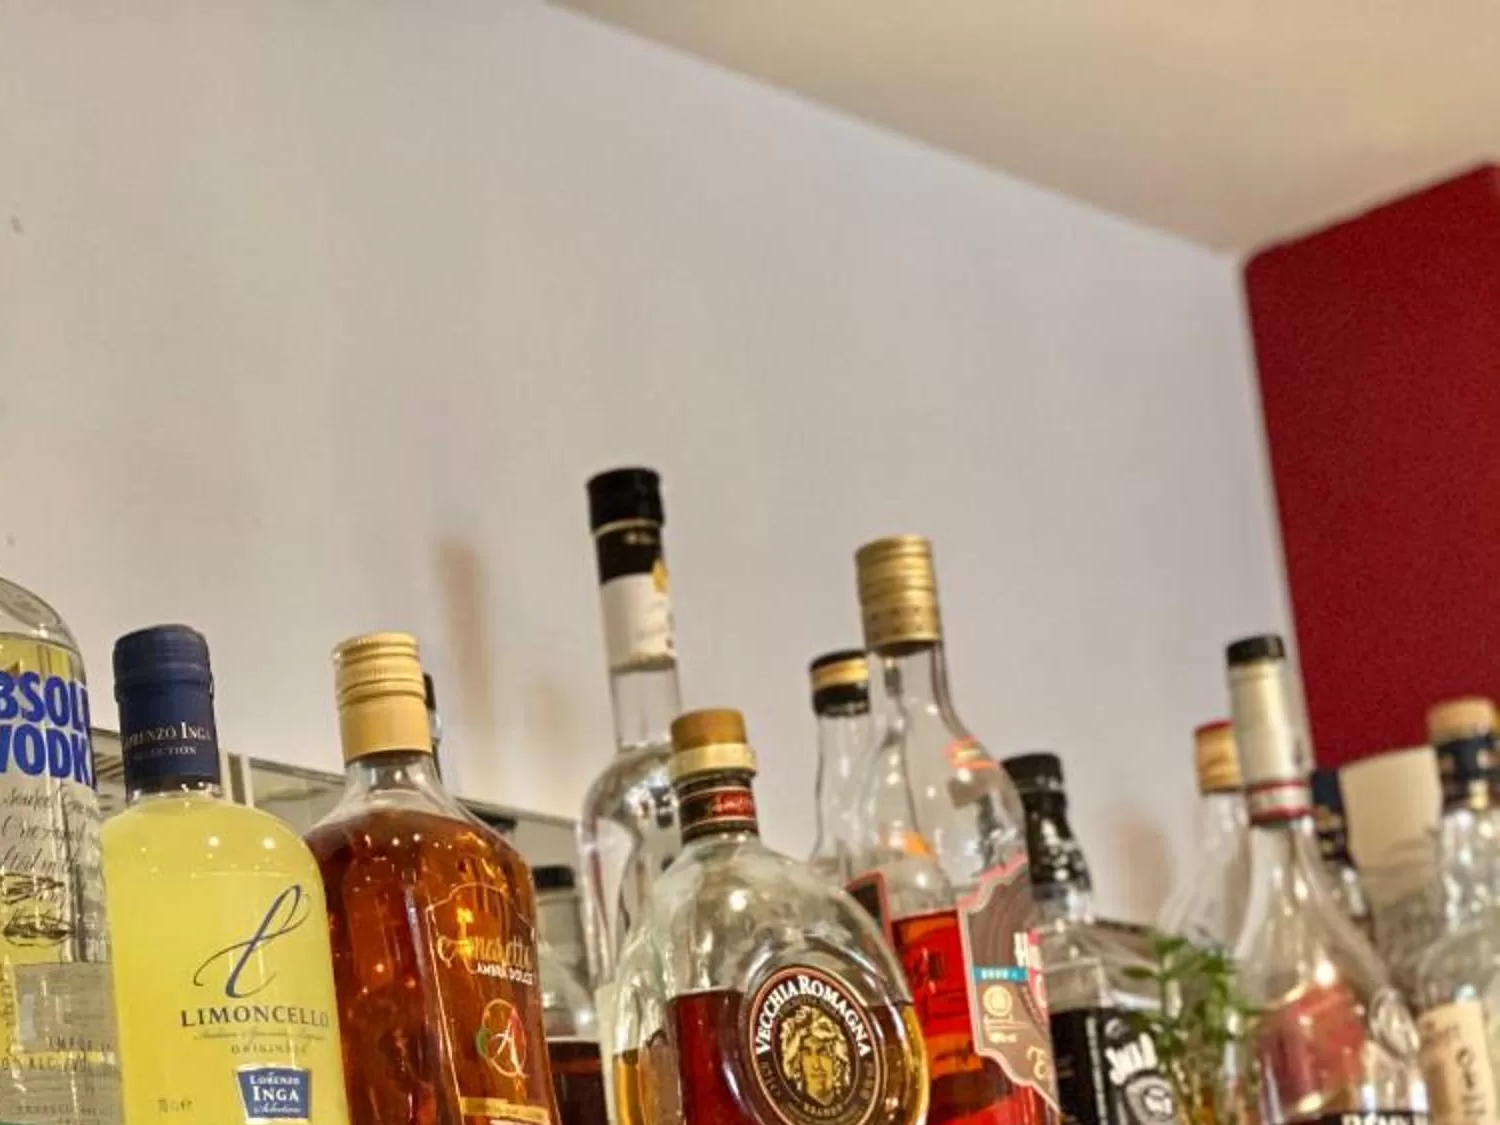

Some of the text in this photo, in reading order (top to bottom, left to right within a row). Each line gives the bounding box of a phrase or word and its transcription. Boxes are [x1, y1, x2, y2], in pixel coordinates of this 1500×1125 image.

[181, 721, 212, 741] INGA
[180, 1004, 331, 1029] LIMONCELLO
[755, 974, 872, 1057] VECCHIA ROMAGNA
[249, 1073, 301, 1085] LORENZO
[252, 1085, 300, 1102] INGA
